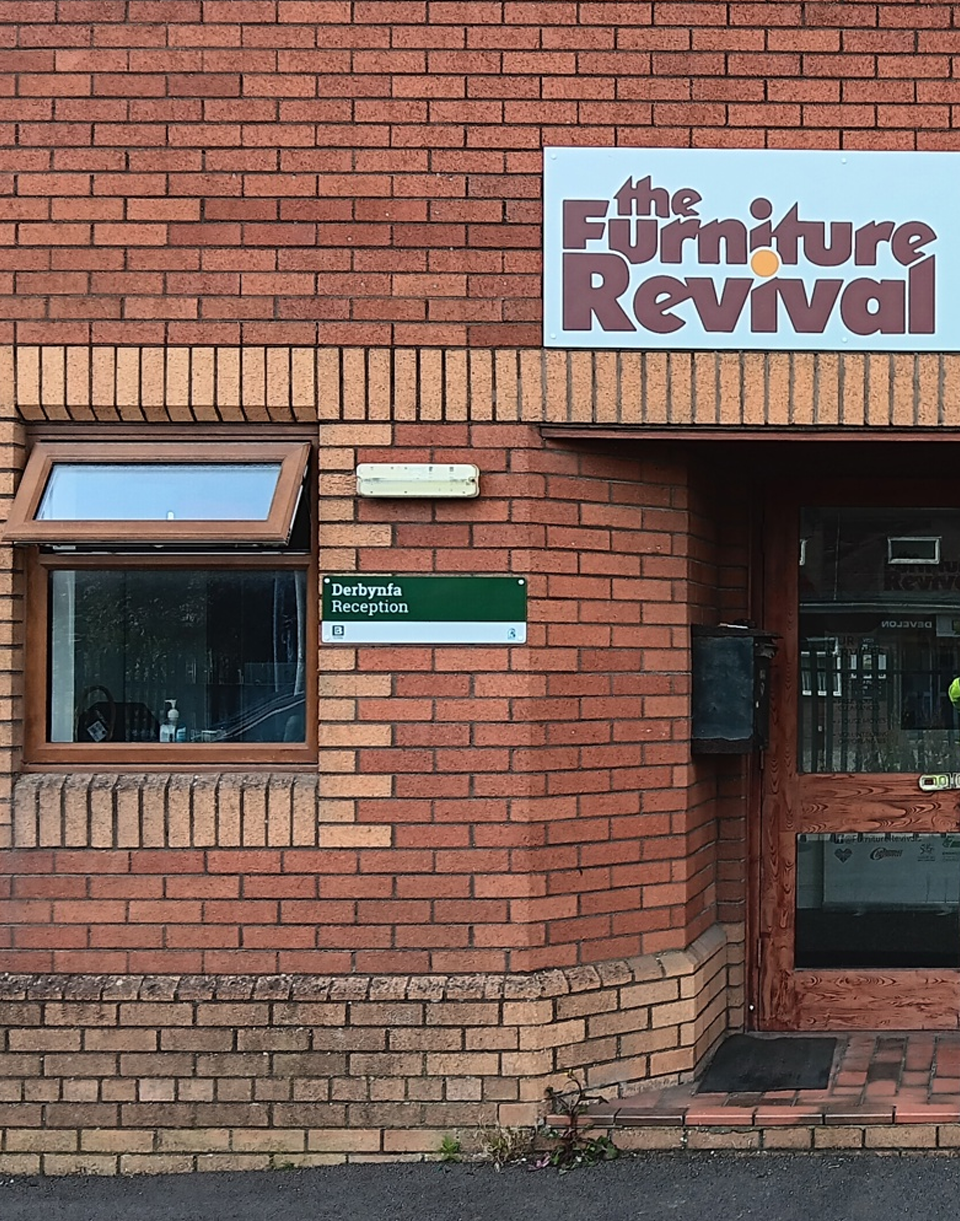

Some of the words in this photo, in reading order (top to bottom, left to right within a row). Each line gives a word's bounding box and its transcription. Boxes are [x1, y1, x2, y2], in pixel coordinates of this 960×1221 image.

[615, 176, 702, 216] the
[562, 197, 938, 268] Furniture
[562, 252, 936, 336] Revival
[331, 583, 402, 600] Derbynfa
[331, 599, 409, 616] Reception
